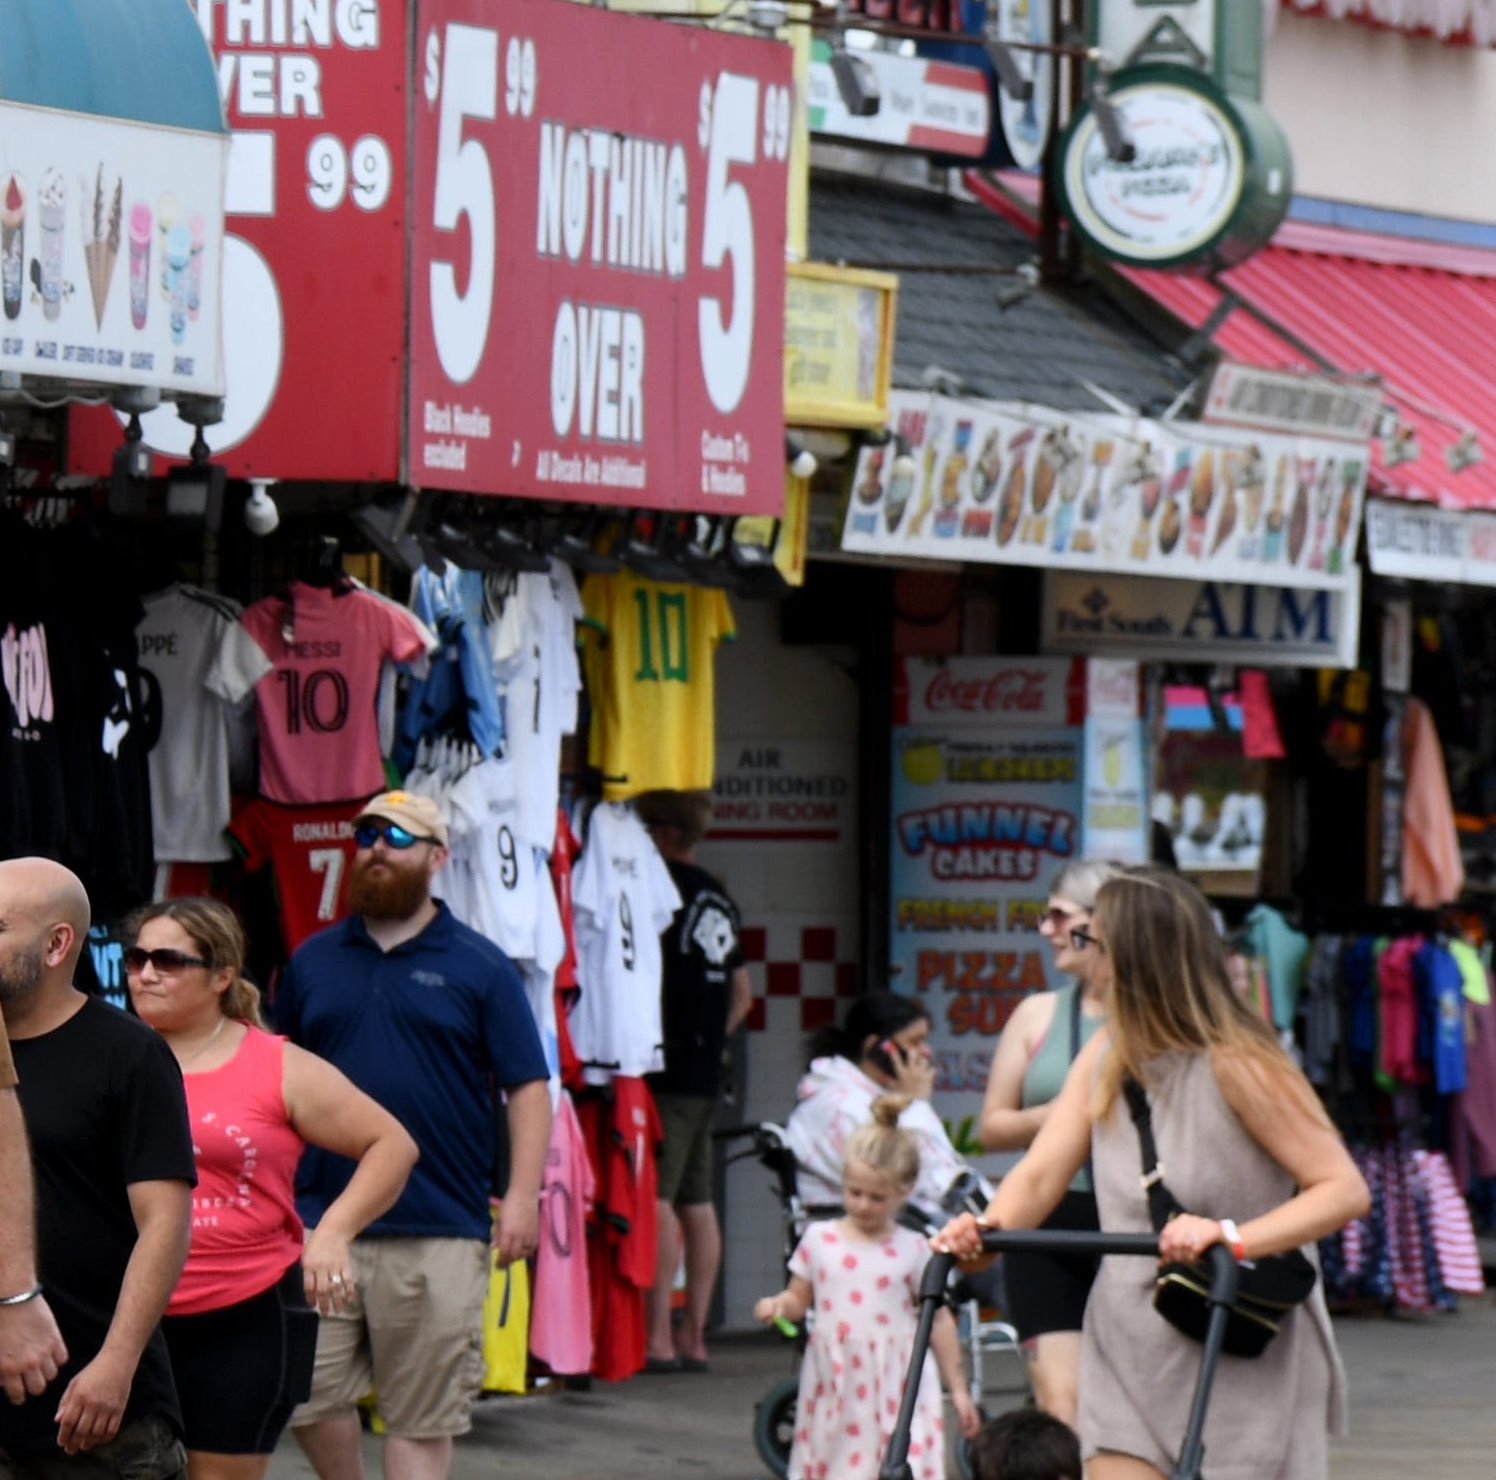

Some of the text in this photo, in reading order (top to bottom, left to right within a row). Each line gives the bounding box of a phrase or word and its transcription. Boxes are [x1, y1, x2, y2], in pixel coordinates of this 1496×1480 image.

[536, 118, 688, 280] NOTHING
[551, 301, 644, 444] OVER
[285, 640, 340, 658] MESSI
[634, 589, 687, 682] 10
[278, 670, 348, 734] 10
[739, 747, 781, 768] AIR
[768, 802, 838, 820] ROOM
[899, 803, 1077, 856] FUNNEL
[309, 848, 345, 920] 7
[497, 825, 517, 890] 9
[933, 848, 1038, 880] CAKES
[899, 900, 999, 931] FRENCH
[916, 951, 1045, 993] PIZZA
